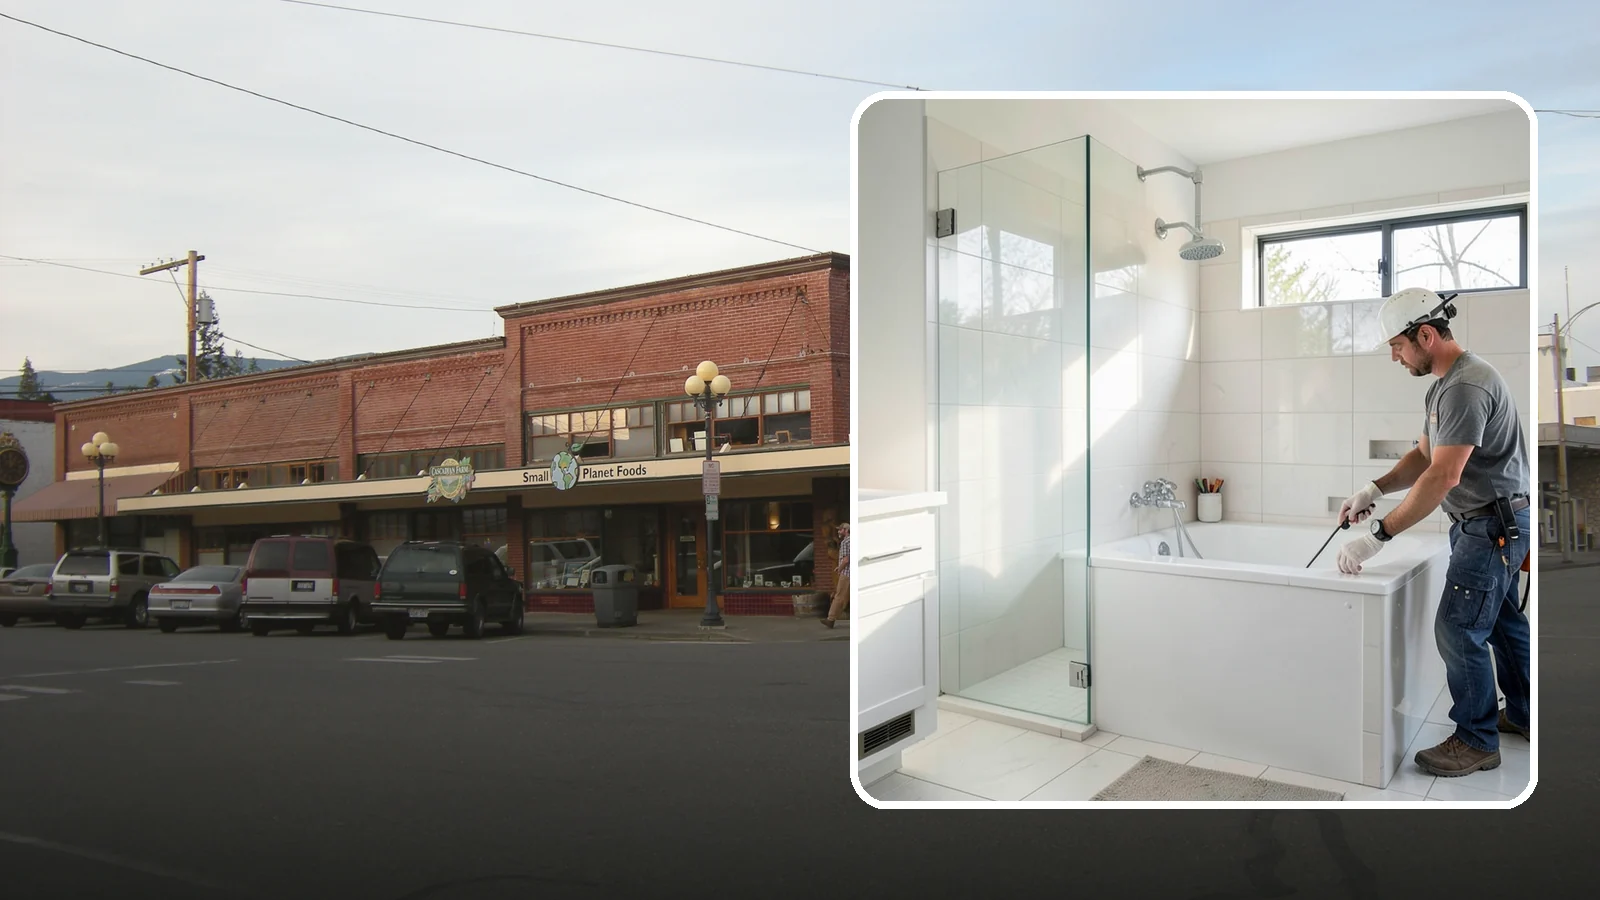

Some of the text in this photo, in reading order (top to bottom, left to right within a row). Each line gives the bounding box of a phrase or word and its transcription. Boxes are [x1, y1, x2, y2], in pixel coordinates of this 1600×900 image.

[523, 464, 647, 483] Small Planet Foods
